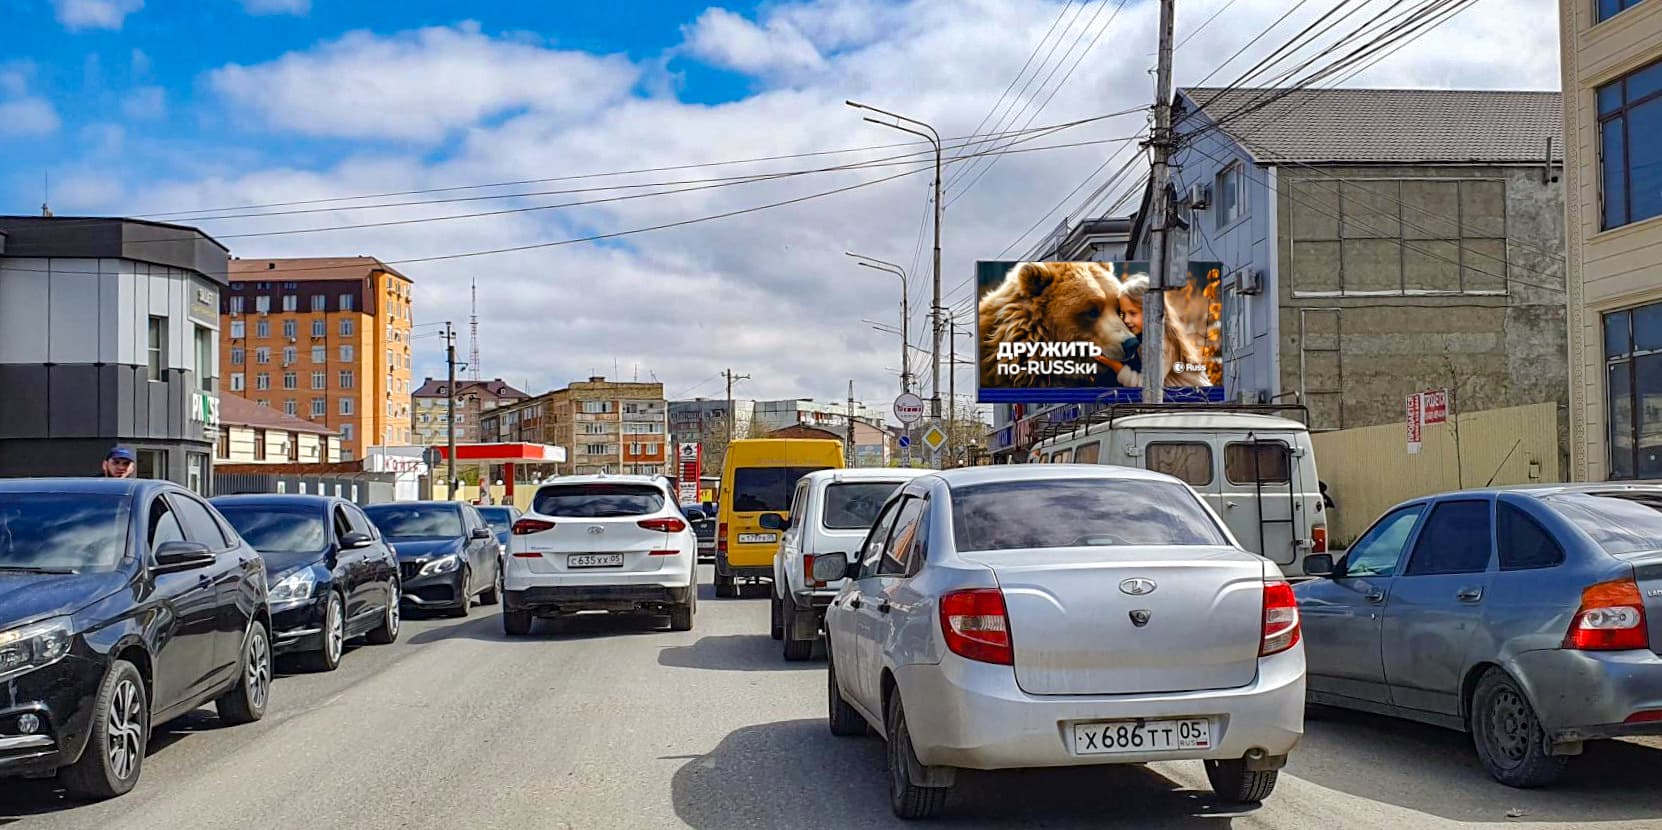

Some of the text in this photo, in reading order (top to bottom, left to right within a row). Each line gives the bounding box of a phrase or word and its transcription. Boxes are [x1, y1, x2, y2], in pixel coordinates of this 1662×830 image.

[997, 341, 1102, 360] ДРУЖИТЬ
[998, 360, 1097, 375] по-RUSSки
[1185, 363, 1206, 371] Russ
[1085, 722, 1201, 750] Х686ТТ 05
